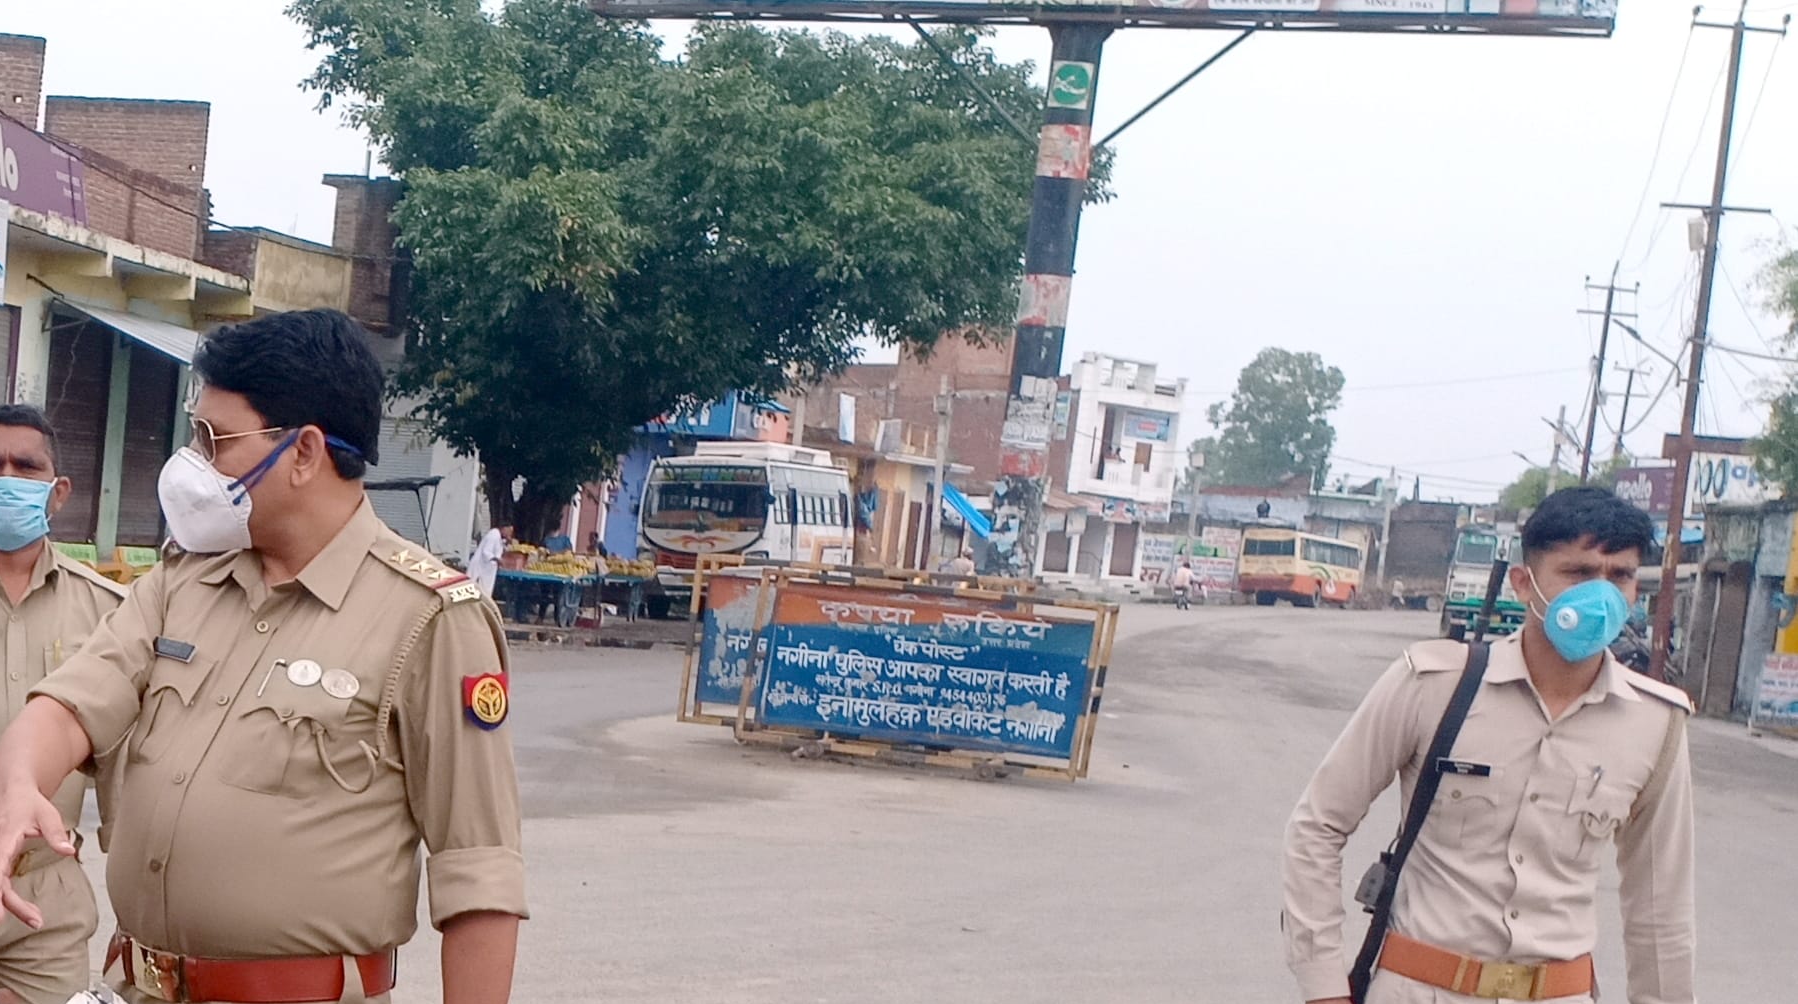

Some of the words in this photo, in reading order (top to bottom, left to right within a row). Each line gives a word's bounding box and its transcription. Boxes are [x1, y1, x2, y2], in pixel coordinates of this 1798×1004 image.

[777, 645, 831, 670] नगीना
[834, 653, 884, 677] पुलिस
[886, 661, 943, 685] आपका
[947, 667, 1006, 694] स्वागत
[1007, 672, 1053, 697] करती
[1054, 671, 1070, 702] है
